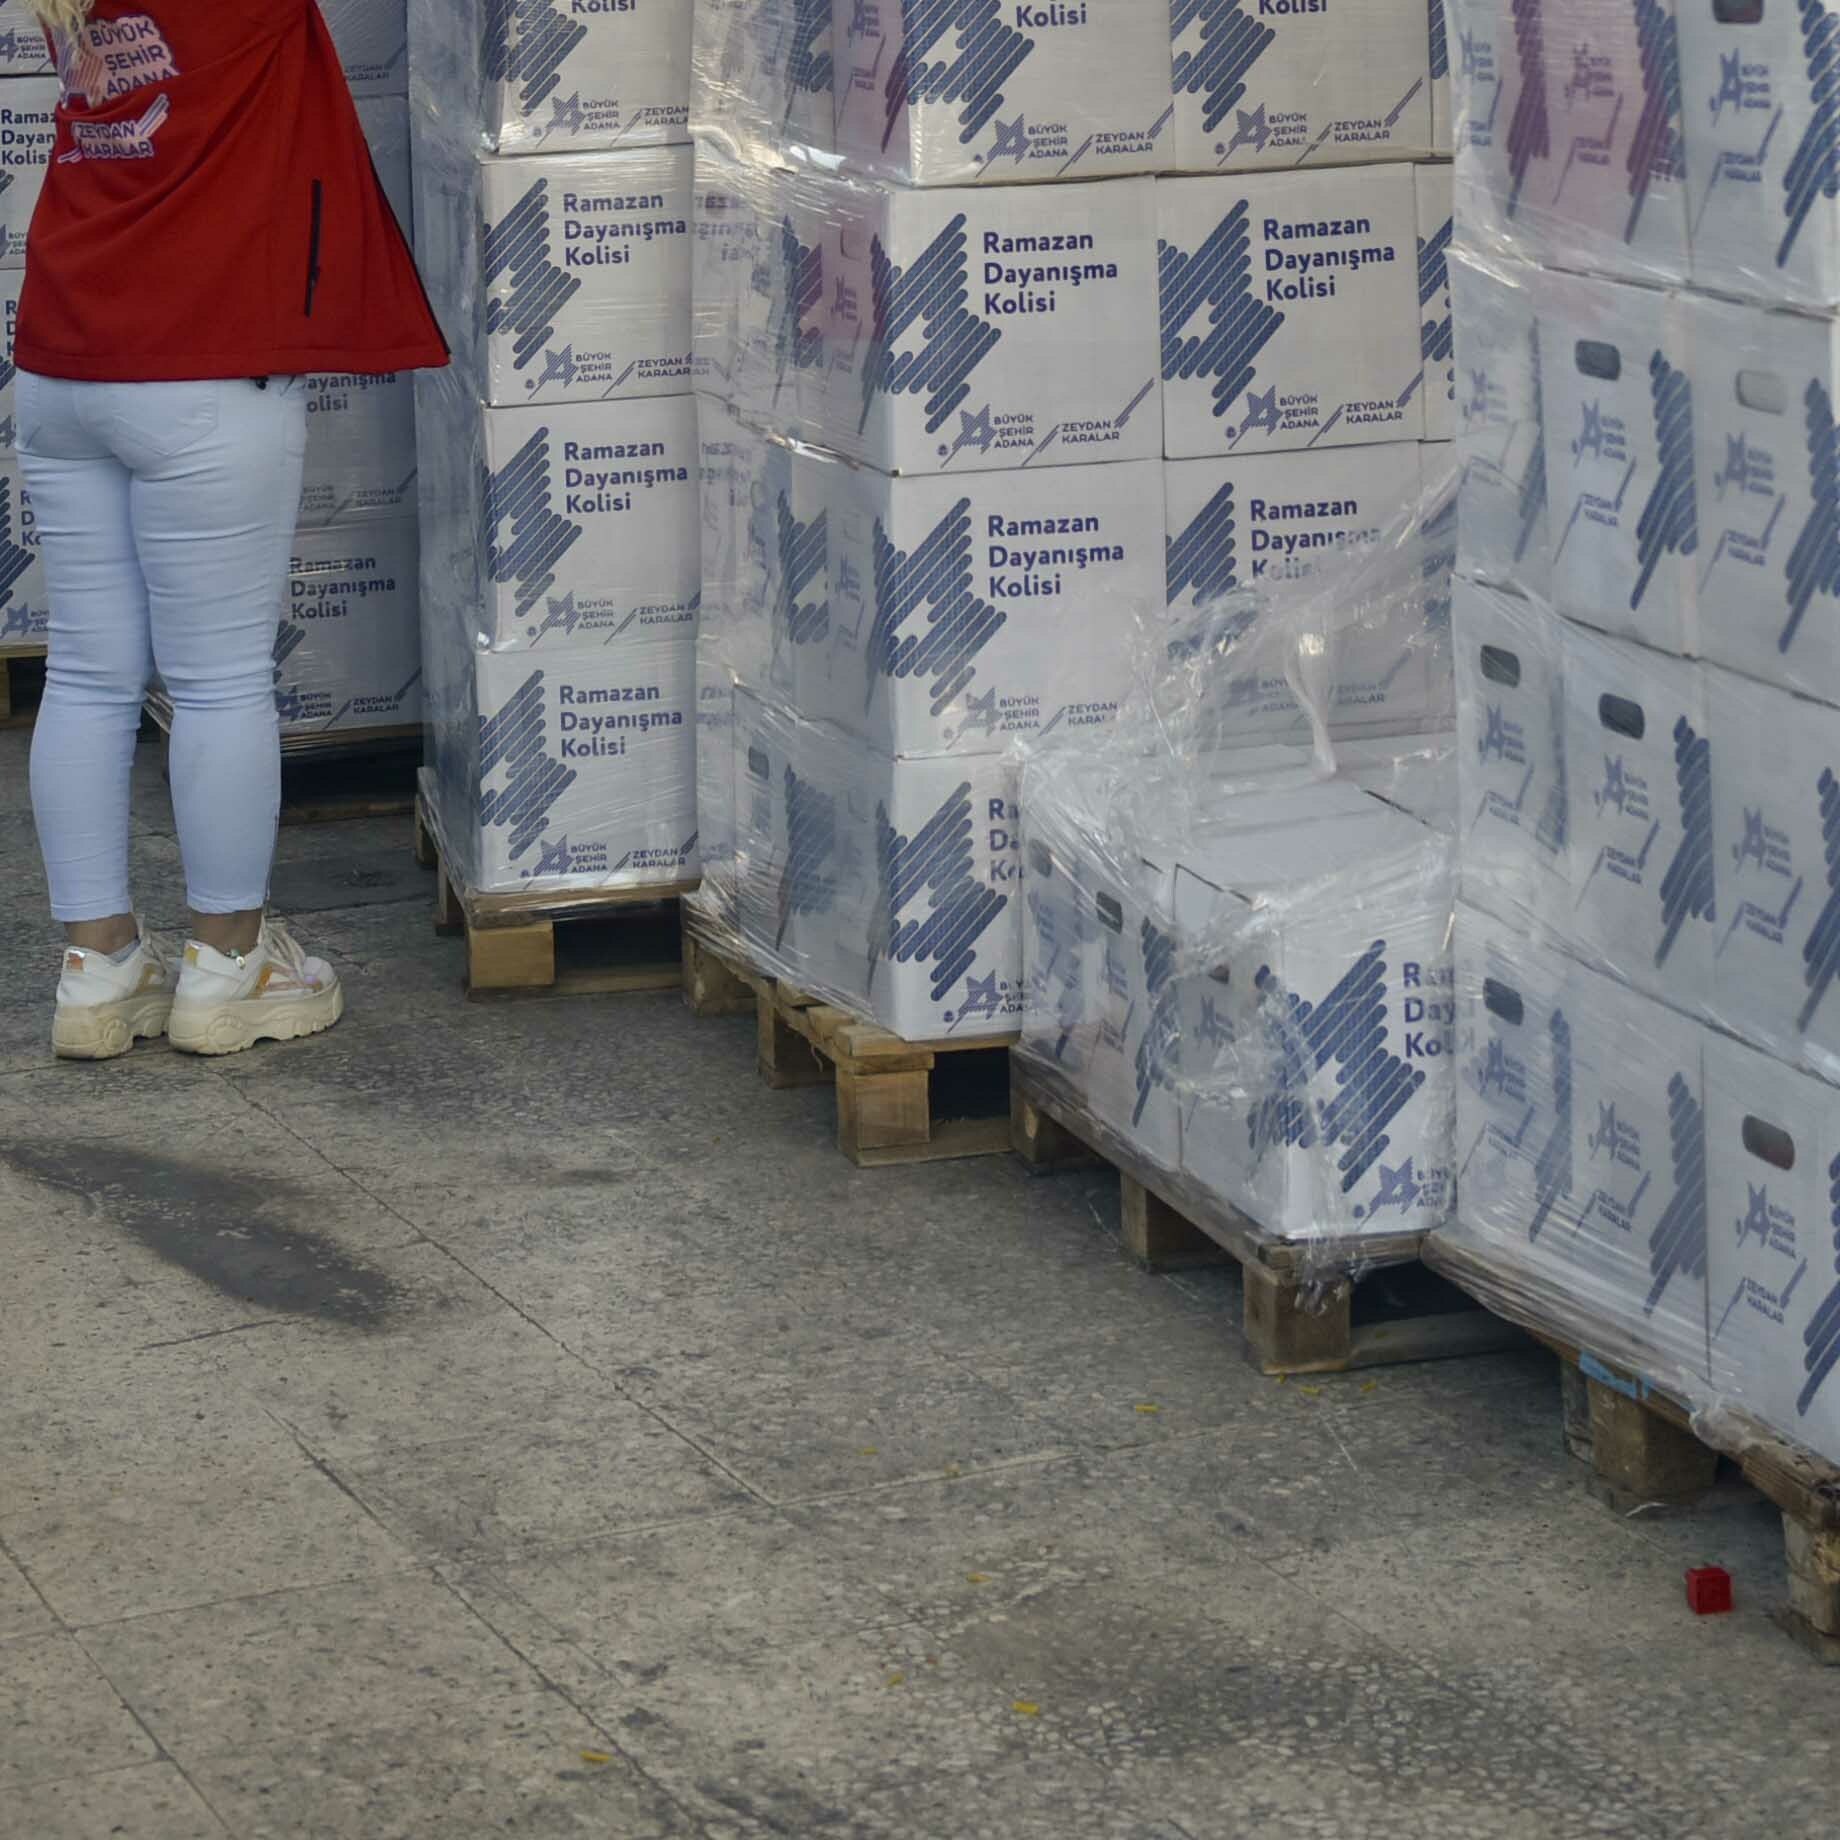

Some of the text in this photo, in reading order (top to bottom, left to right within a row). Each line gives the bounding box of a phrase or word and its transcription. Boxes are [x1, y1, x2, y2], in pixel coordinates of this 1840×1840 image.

[1016, 3, 1086, 28] Kolisi
[90, 20, 153, 47] BÜYÜK
[105, 44, 165, 76] ŞEHİR
[1, 109, 56, 124] Ramaz
[1, 129, 55, 147] Dayan
[79, 122, 135, 138] ZEYDAN
[1, 149, 52, 164] Kolis
[84, 141, 152, 156] KARALAR
[564, 193, 663, 212] Ramazan
[565, 220, 685, 243] Dayanışma
[1264, 219, 1370, 240] Ramazan
[984, 232, 1093, 253] Ramazan
[566, 245, 629, 266] Kolisi
[1265, 247, 1394, 274] Dayanışma
[985, 262, 1117, 288] Dayanışma
[1267, 275, 1335, 301] Kolisi
[985, 291, 1054, 314] Kolisi
[576, 352, 612, 361] BÜYÜK
[638, 357, 682, 368] ZEYDAN
[576, 372, 612, 382] ADANA
[638, 367, 691, 378] KARALAR
[1280, 394, 1318, 406] BÜYÜK
[1346, 400, 1394, 412] ZEYDAN
[994, 414, 1033, 425] BÜYÜK
[1284, 406, 1319, 420] ŞEHİR
[1346, 411, 1403, 424] KARALAR
[999, 425, 1034, 439] ŞEHİR
[1062, 420, 1111, 432] ZEYDAN
[1280, 419, 1319, 429] ADANA
[994, 438, 1035, 448] ADANA
[1062, 431, 1120, 443] KARALAR
[565, 442, 664, 461] Ramazan
[566, 468, 687, 490] Dayanışma
[567, 492, 630, 514] Kolisi
[1251, 500, 1357, 521] Ramazan
[989, 515, 1098, 537] Ramazan
[989, 546, 1123, 572] Dayanışma
[990, 574, 1060, 598] Kolisi
[560, 686, 659, 704] Ramazan
[561, 712, 682, 734] Dayanışma
[562, 736, 625, 757] Kolisi
